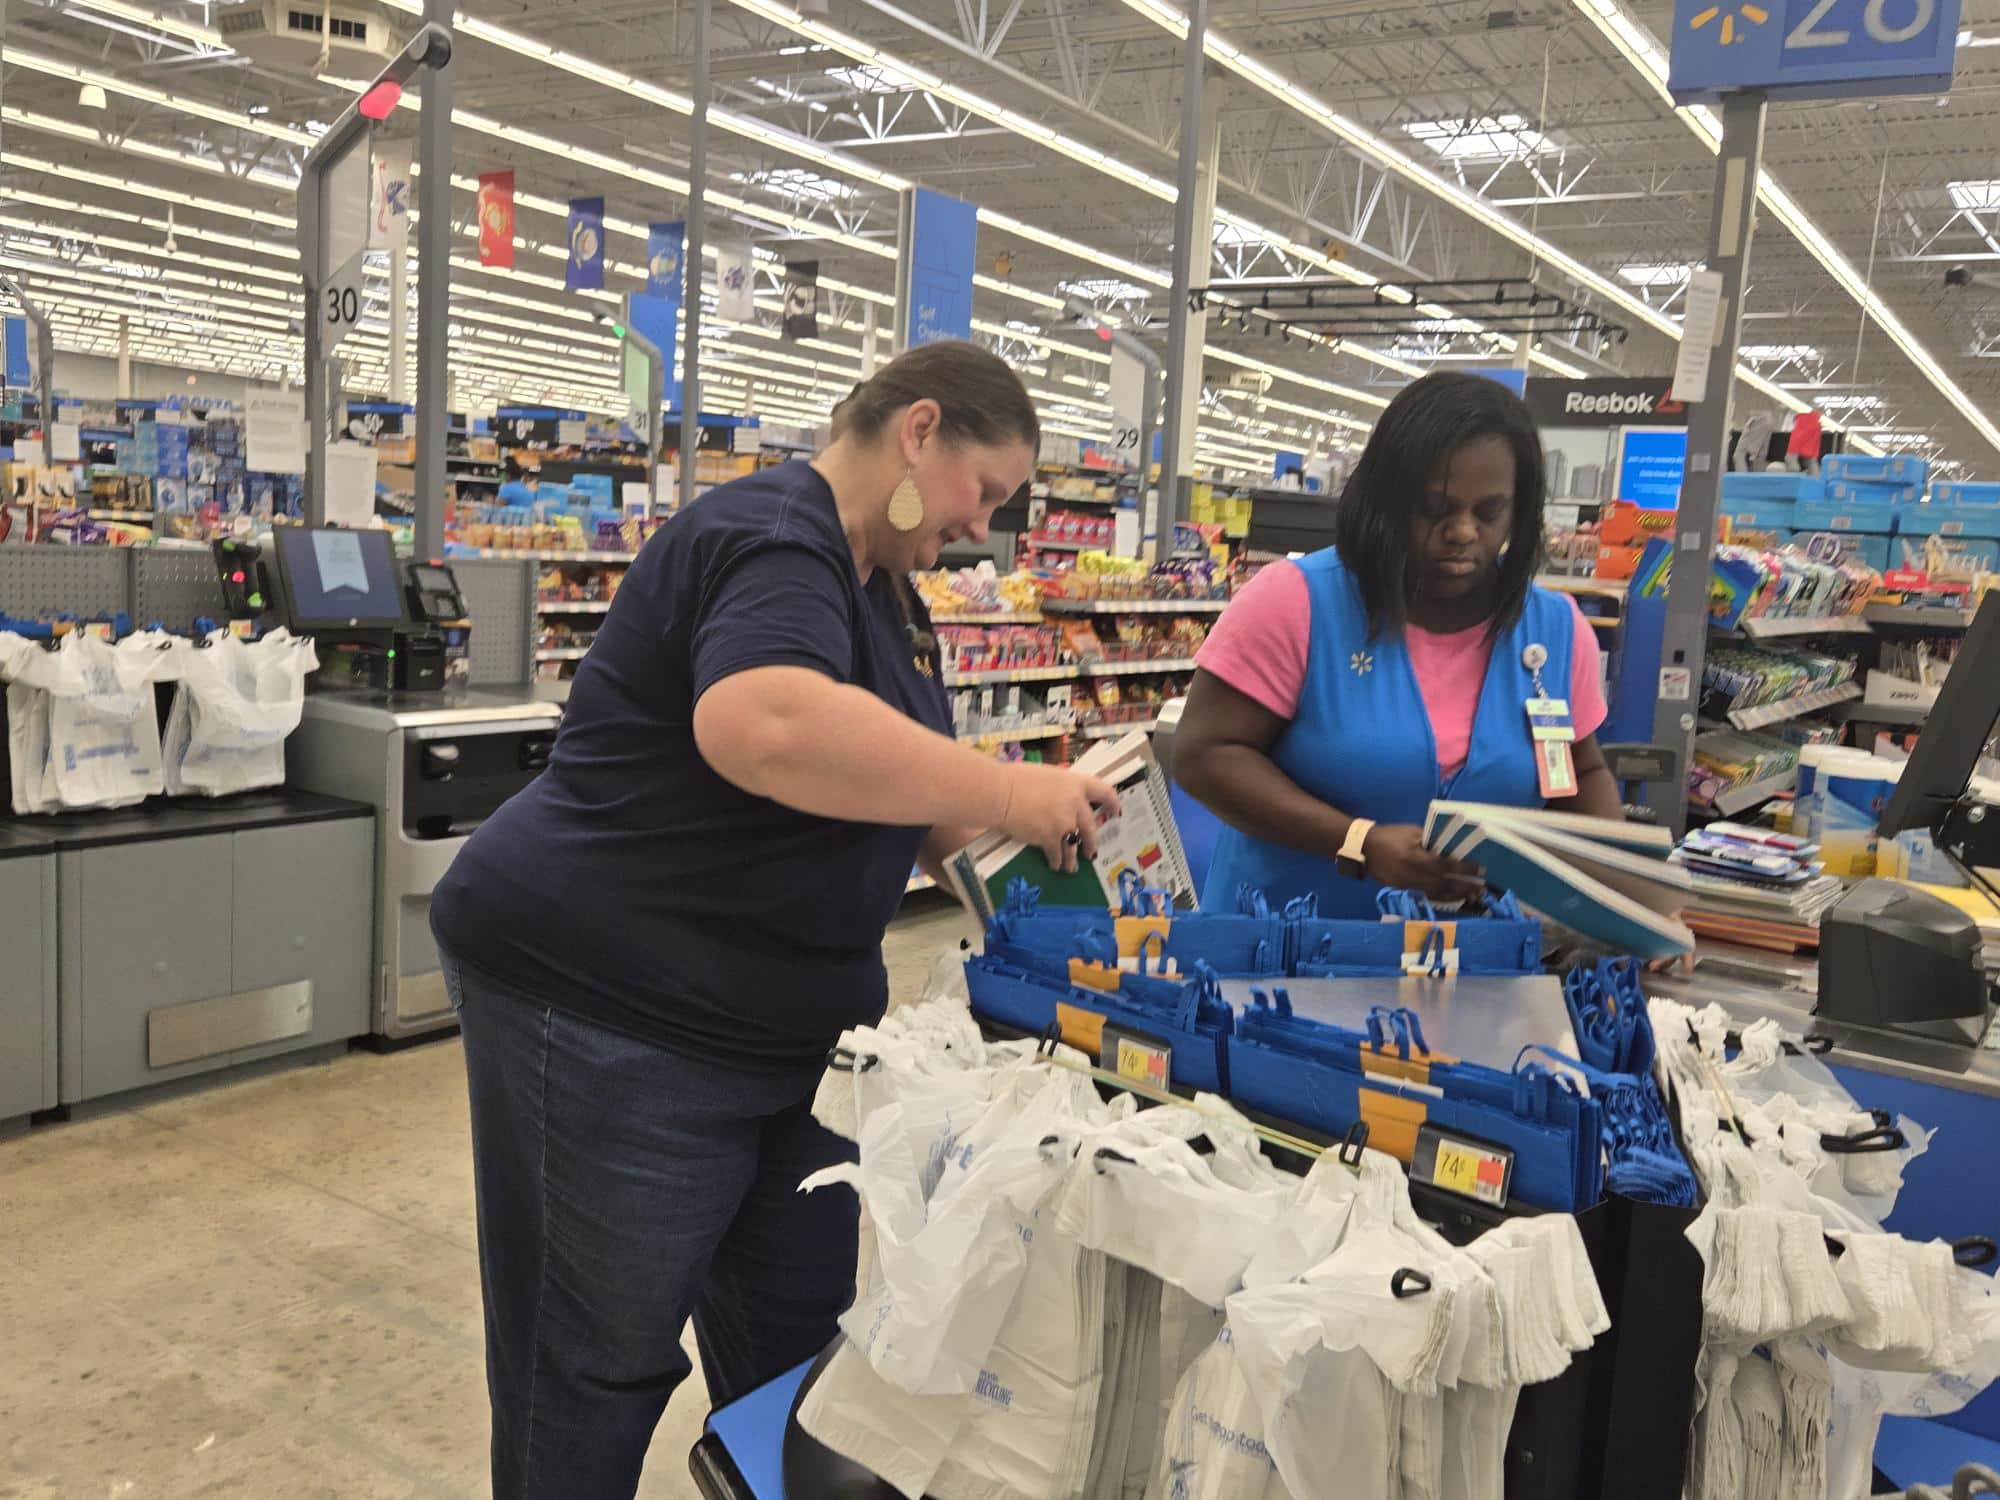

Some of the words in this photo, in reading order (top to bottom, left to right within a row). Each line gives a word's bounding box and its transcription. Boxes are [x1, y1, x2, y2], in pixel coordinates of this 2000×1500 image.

[327, 287, 357, 323] 30
[1565, 392, 1655, 414] Reebok
[1116, 428, 1138, 449] 29
